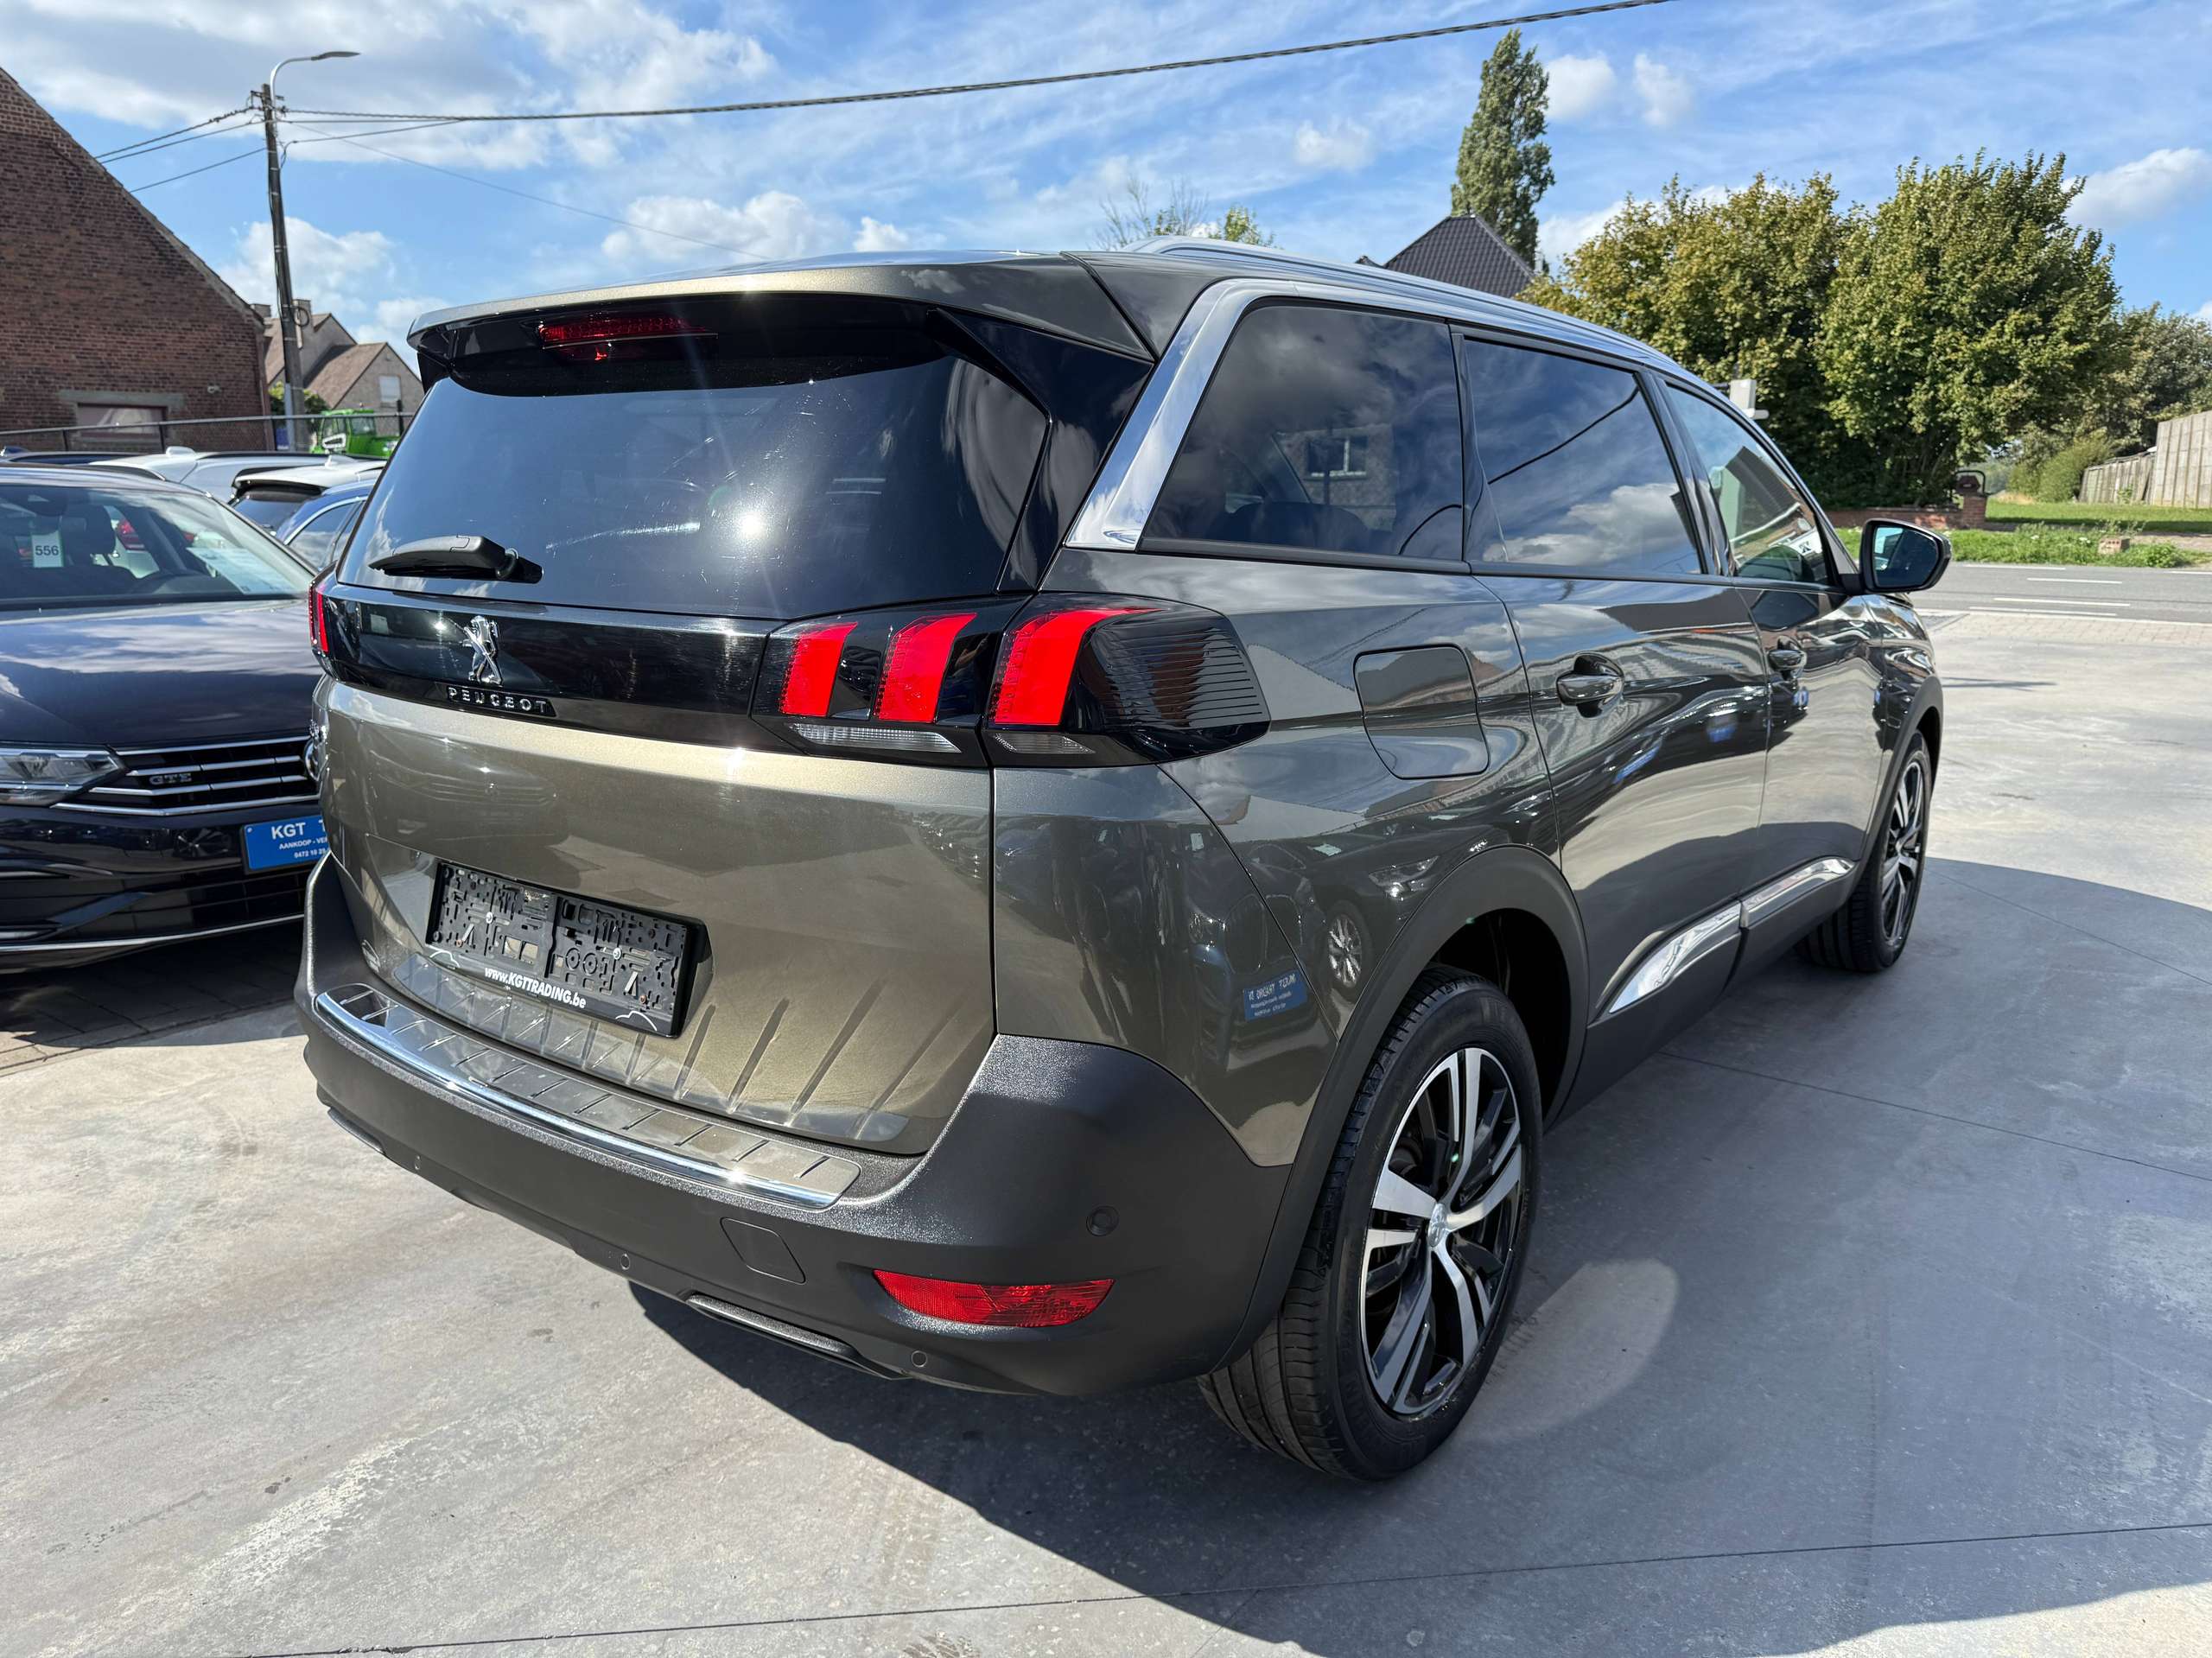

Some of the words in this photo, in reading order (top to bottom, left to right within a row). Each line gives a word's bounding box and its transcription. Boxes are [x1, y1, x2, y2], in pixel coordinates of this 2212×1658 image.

[35, 545, 60, 556] 556
[448, 687, 547, 714] PEUGEOT
[149, 773, 192, 785] GTE
[270, 822, 306, 840] KGT
[484, 967, 587, 1009] www.KGTTRADING.be
